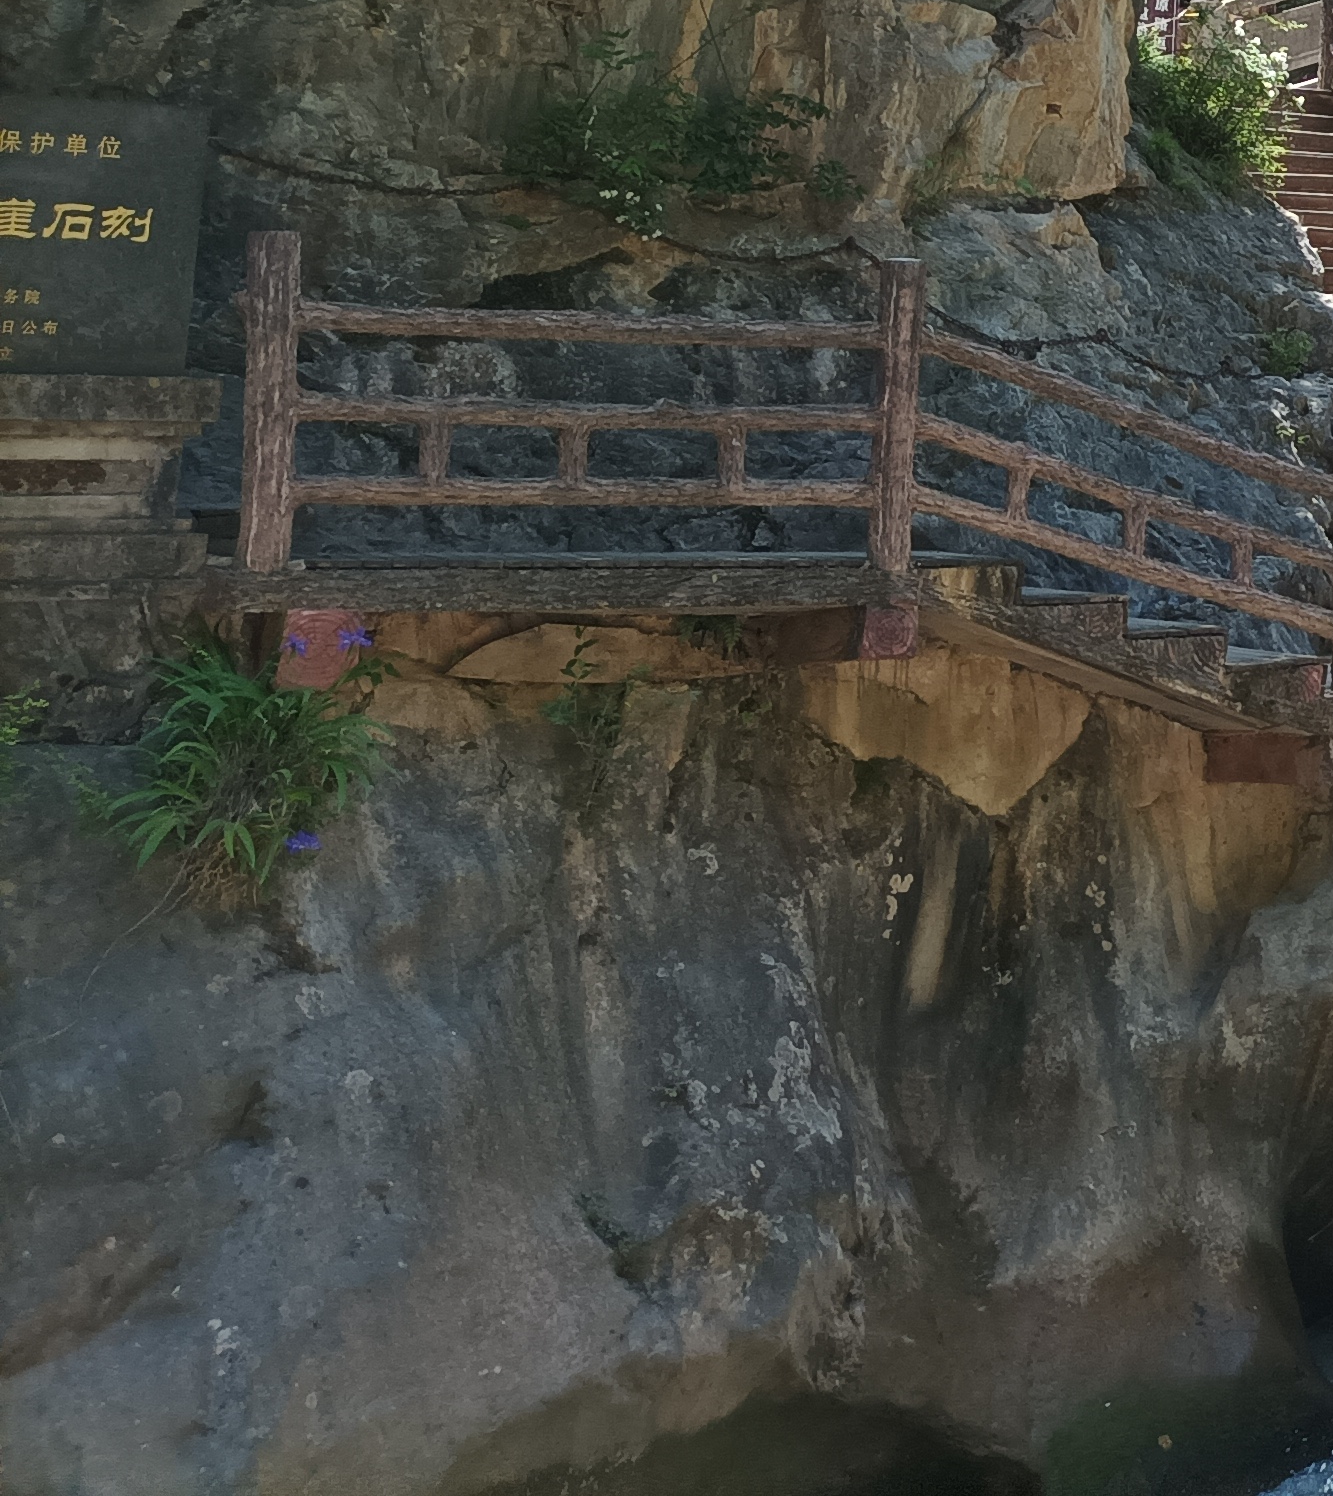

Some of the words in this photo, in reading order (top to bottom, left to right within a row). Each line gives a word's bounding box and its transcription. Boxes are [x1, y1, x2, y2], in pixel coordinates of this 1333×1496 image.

[0, 128, 121, 159] 保护单位
[0, 197, 153, 242] 崖石刻
[4, 287, 41, 305] 务院
[2, 319, 59, 335] 日公布
